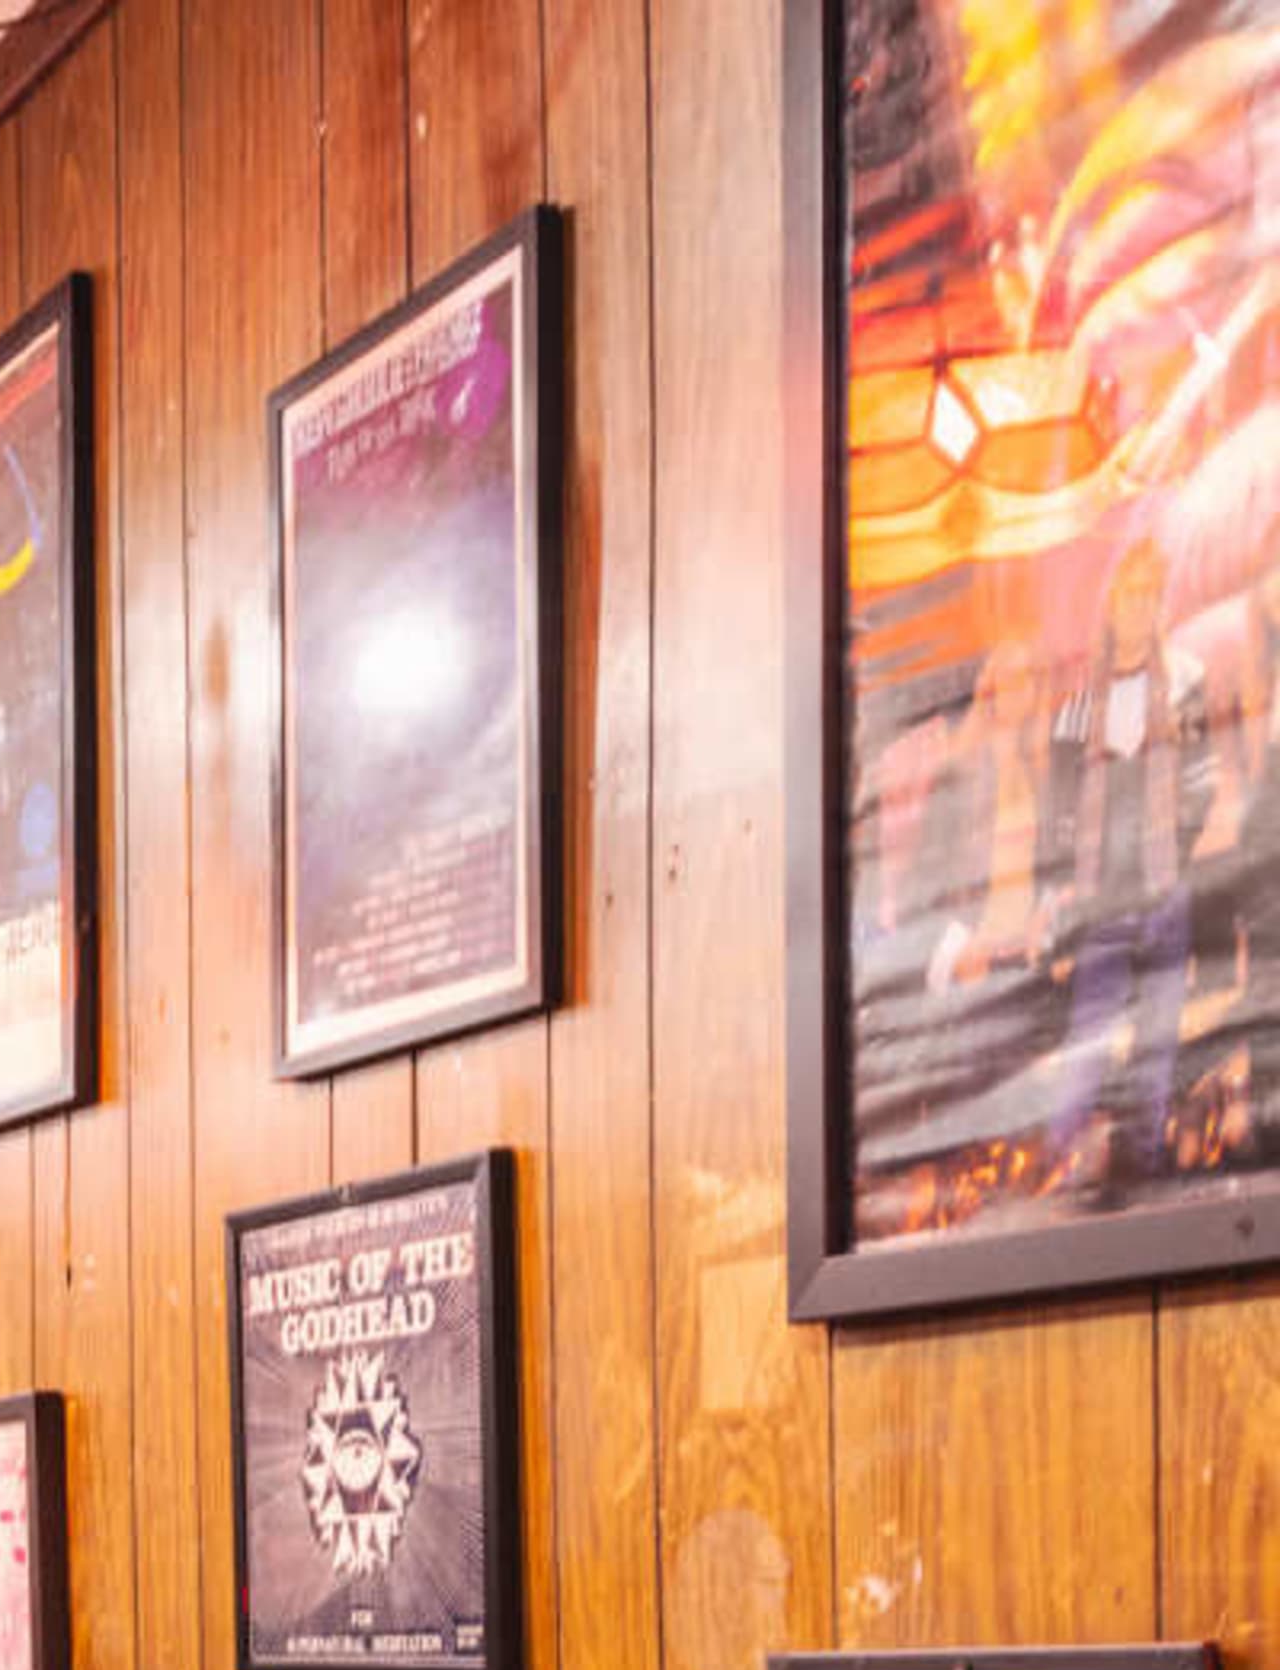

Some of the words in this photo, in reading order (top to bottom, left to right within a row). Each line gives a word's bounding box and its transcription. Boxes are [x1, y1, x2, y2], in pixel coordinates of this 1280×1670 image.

[248, 1258, 341, 1316] MUSIC
[348, 1249, 392, 1298] OF
[400, 1231, 475, 1286] THE
[281, 1290, 436, 1354] GODHEAD
